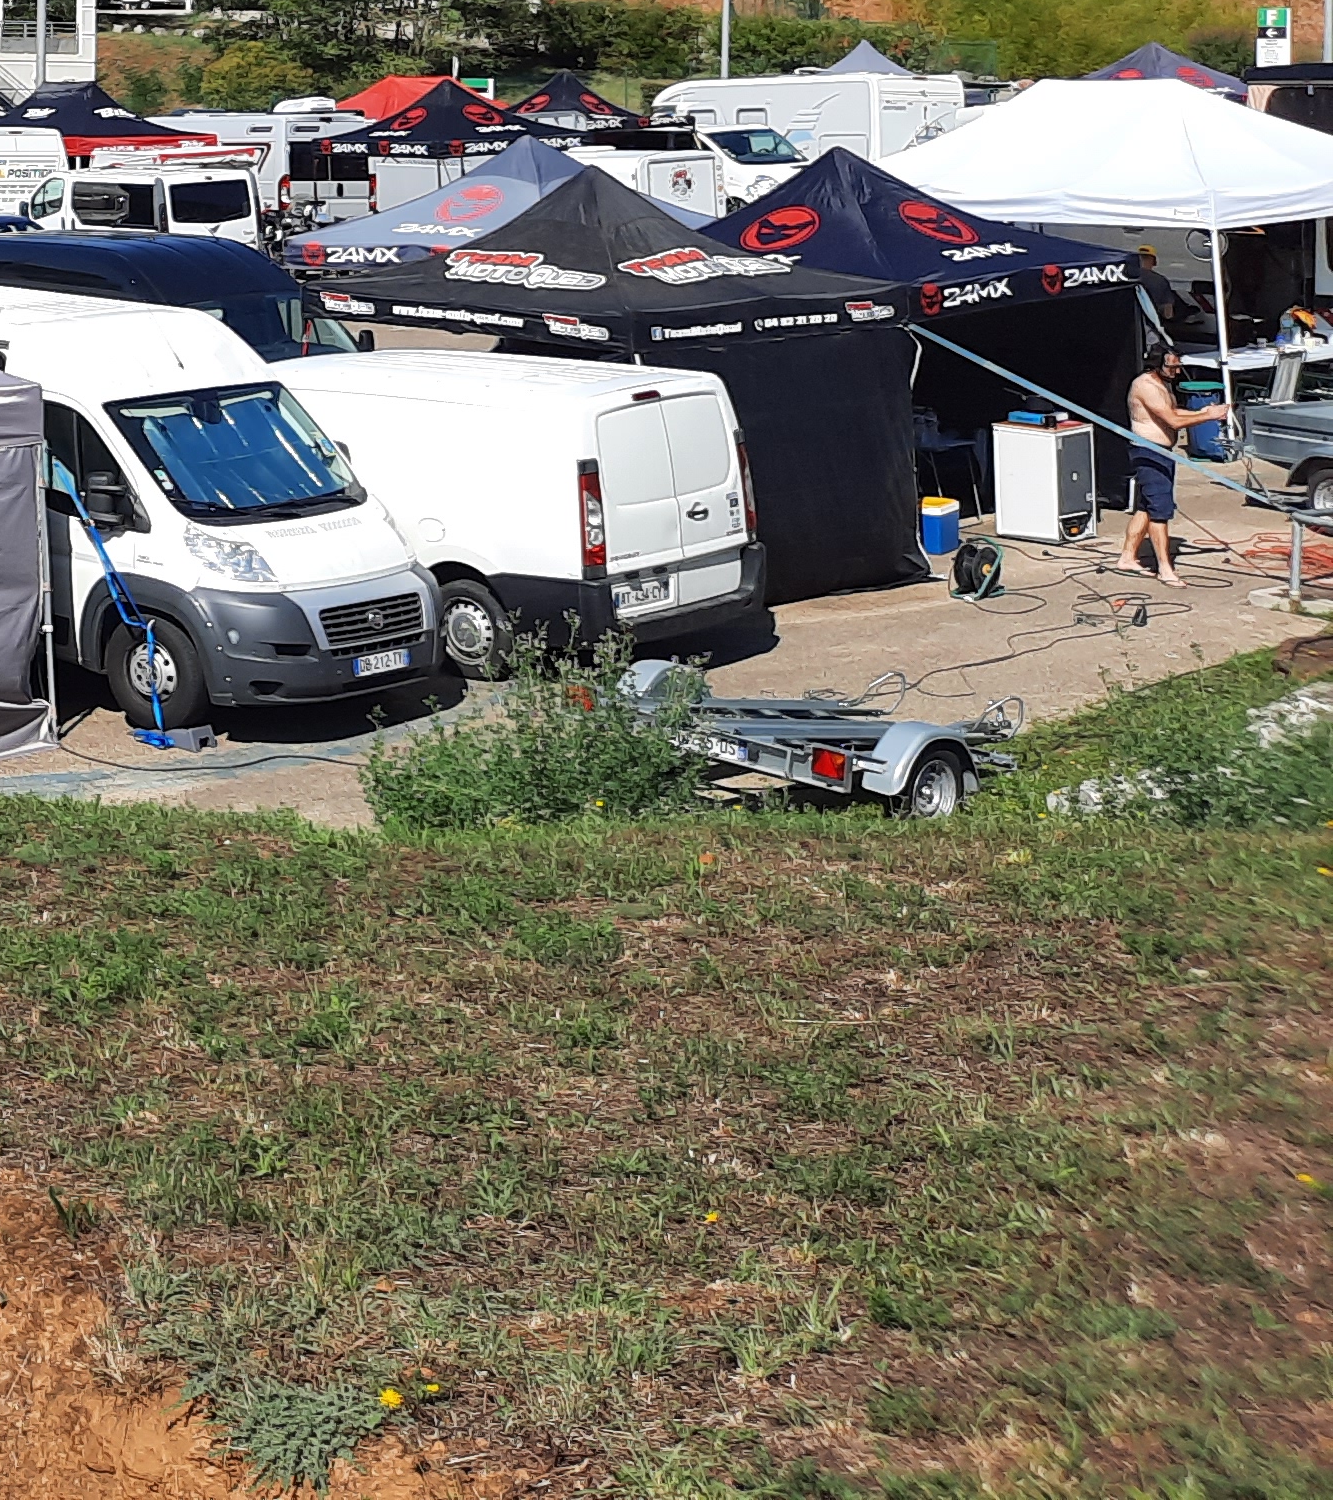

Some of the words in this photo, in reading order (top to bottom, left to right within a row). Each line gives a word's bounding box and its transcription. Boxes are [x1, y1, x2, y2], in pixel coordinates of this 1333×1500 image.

[1266, 9, 1279, 26] F
[332, 143, 368, 153] 24MX
[390, 143, 428, 155] 24MX
[327, 246, 401, 264] 24MX
[450, 251, 540, 267] TEAM
[941, 242, 1029, 262] 24MX
[625, 249, 708, 274] TEAM
[1064, 263, 1129, 288] 24MX
[942, 278, 1013, 308] 24MX
